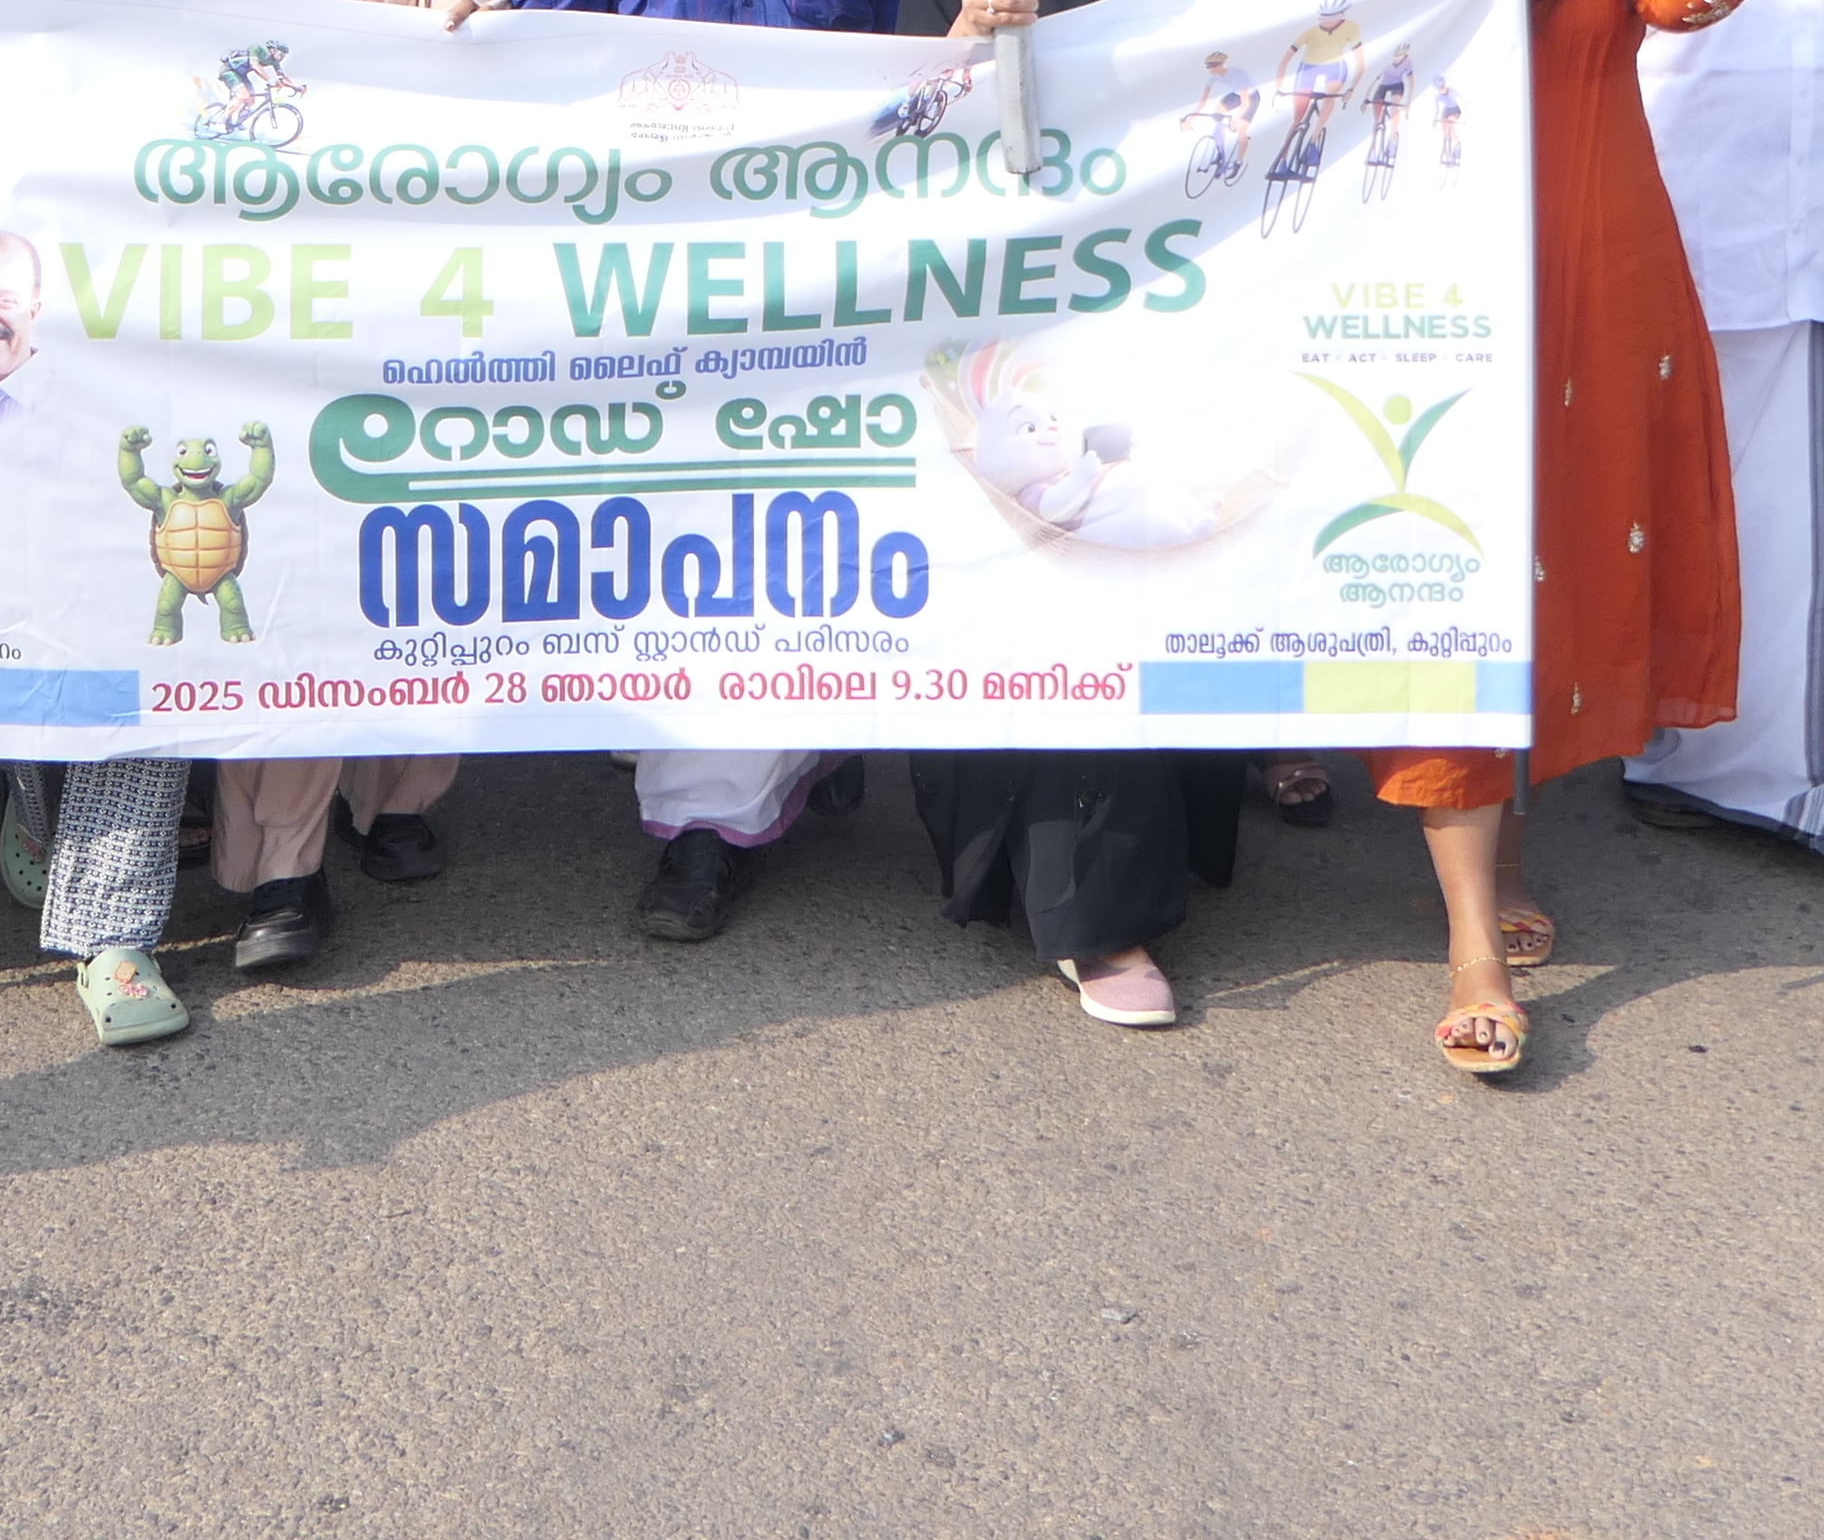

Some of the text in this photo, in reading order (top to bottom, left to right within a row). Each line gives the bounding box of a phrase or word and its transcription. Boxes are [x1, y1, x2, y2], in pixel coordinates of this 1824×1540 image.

[134, 131, 1126, 224] ആരോഗ്യം ആനന്ദം
[62, 219, 1209, 344] VIBE 4 WELLNESS
[1331, 283, 1464, 309] VIBE 4
[1302, 315, 1493, 339] WELLNESS
[381, 336, 868, 386] ഹെൽത്തി ലൈഫ് ക്യാമ്പയിൻ
[1302, 353, 1493, 363] EAT ACT SLEEP CARE
[715, 386, 918, 452] ഷോ
[358, 490, 929, 629] സമാപനം
[1323, 554, 1481, 581] ആരോഗ്യം
[1340, 582, 1465, 607] ആനന്ദം
[373, 622, 912, 666] കുറ്റിപ്പുറം ബസ് സ്റ്റാൻഡ് പരിസരം
[1165, 627, 1264, 659] താലൂക്ക്
[1407, 627, 1513, 658] കുറ്റിപ്പുറം
[151, 661, 1133, 713] 2025 ഡിസംബർ 28 ഞായർ രാവിലെ 9.30 മണിക്ക്
